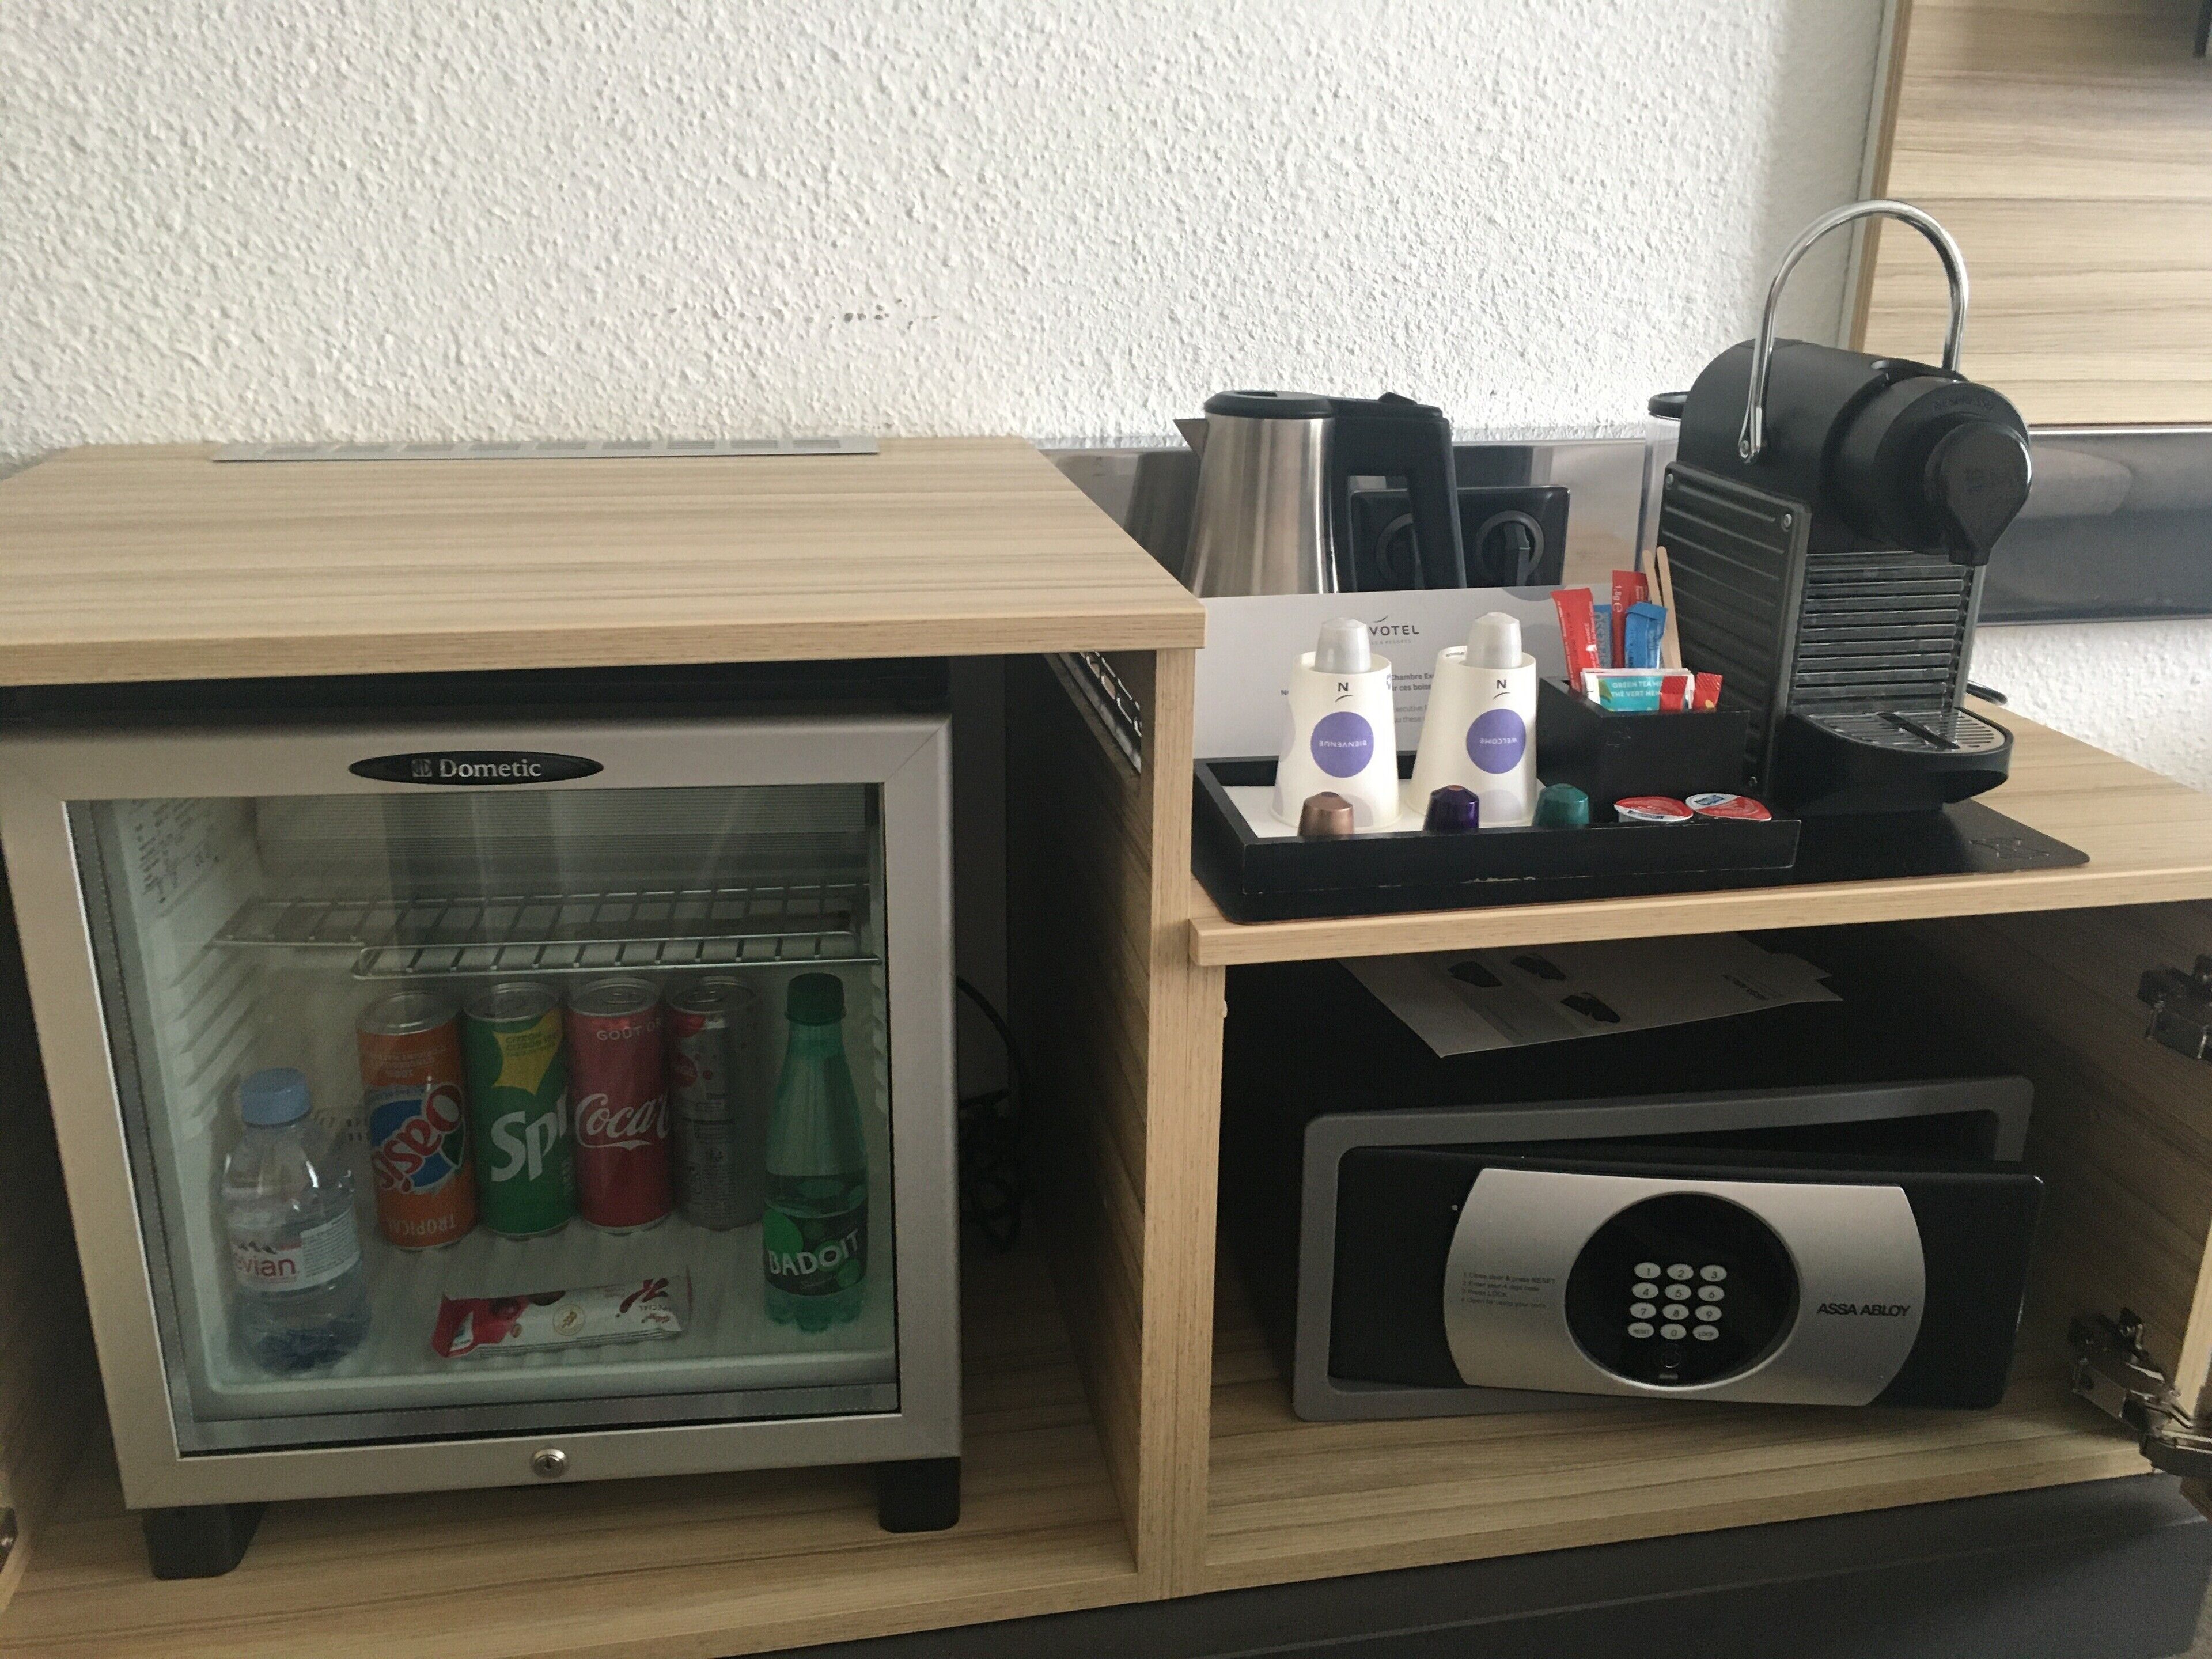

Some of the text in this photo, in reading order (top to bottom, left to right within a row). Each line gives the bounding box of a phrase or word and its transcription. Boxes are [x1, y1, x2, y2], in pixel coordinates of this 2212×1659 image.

[1369, 625, 1419, 635] VOTEL
[1337, 682, 1349, 692] N
[1496, 679, 1507, 690] N
[1319, 740, 1368, 748] BIENVENUE
[440, 758, 542, 777] Dometic
[768, 1228, 859, 1276] BADOIT
[1647, 1268, 1651, 1277] 1
[1678, 1270, 1684, 1278] 2
[1675, 1289, 1682, 1297] 5
[1709, 1290, 1715, 1298] 6
[1641, 1308, 1713, 1319] 7 8 9
[1817, 1302, 1911, 1317] ASSA ABLOY
[1671, 1329, 1677, 1337] 0
